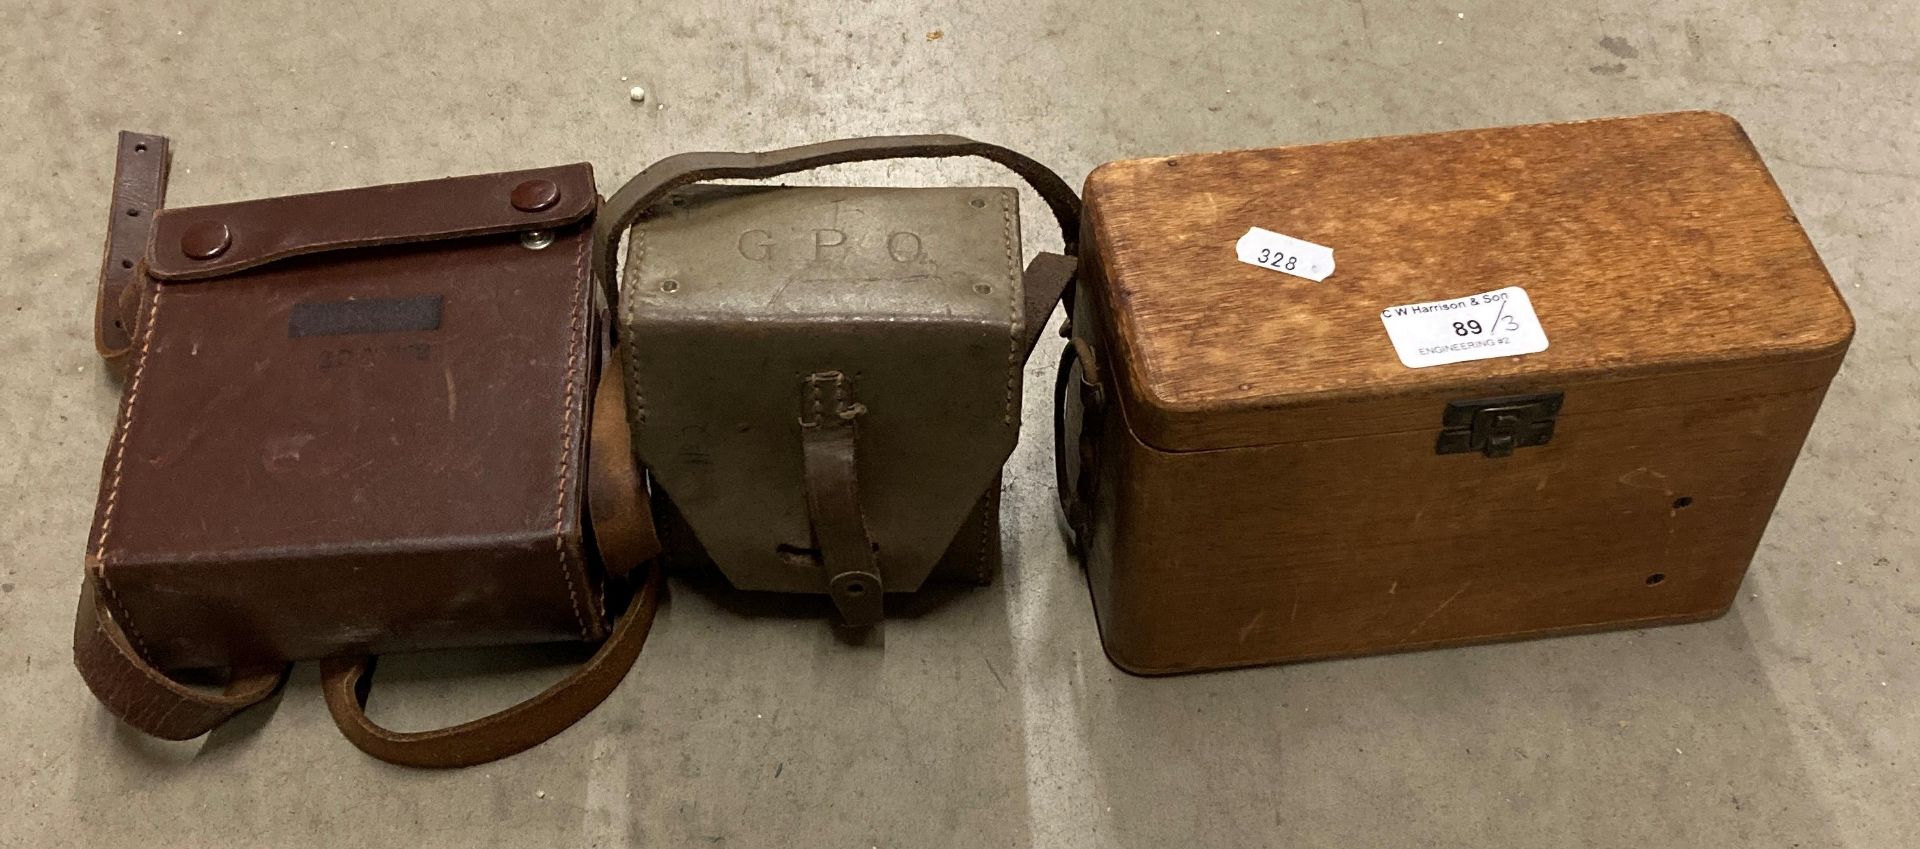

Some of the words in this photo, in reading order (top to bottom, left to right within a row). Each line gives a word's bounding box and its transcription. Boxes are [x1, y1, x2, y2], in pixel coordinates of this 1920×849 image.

[1257, 248, 1298, 271] 328
[1382, 309, 1393, 318] C
[1394, 308, 1408, 317] W
[1412, 301, 1466, 315] Harrison
[1470, 297, 1480, 306] &
[1483, 292, 1509, 304] Son
[1453, 319, 1483, 337] 89
[1418, 339, 1496, 356] ENGINEERING
[1497, 336, 1511, 346] #2
